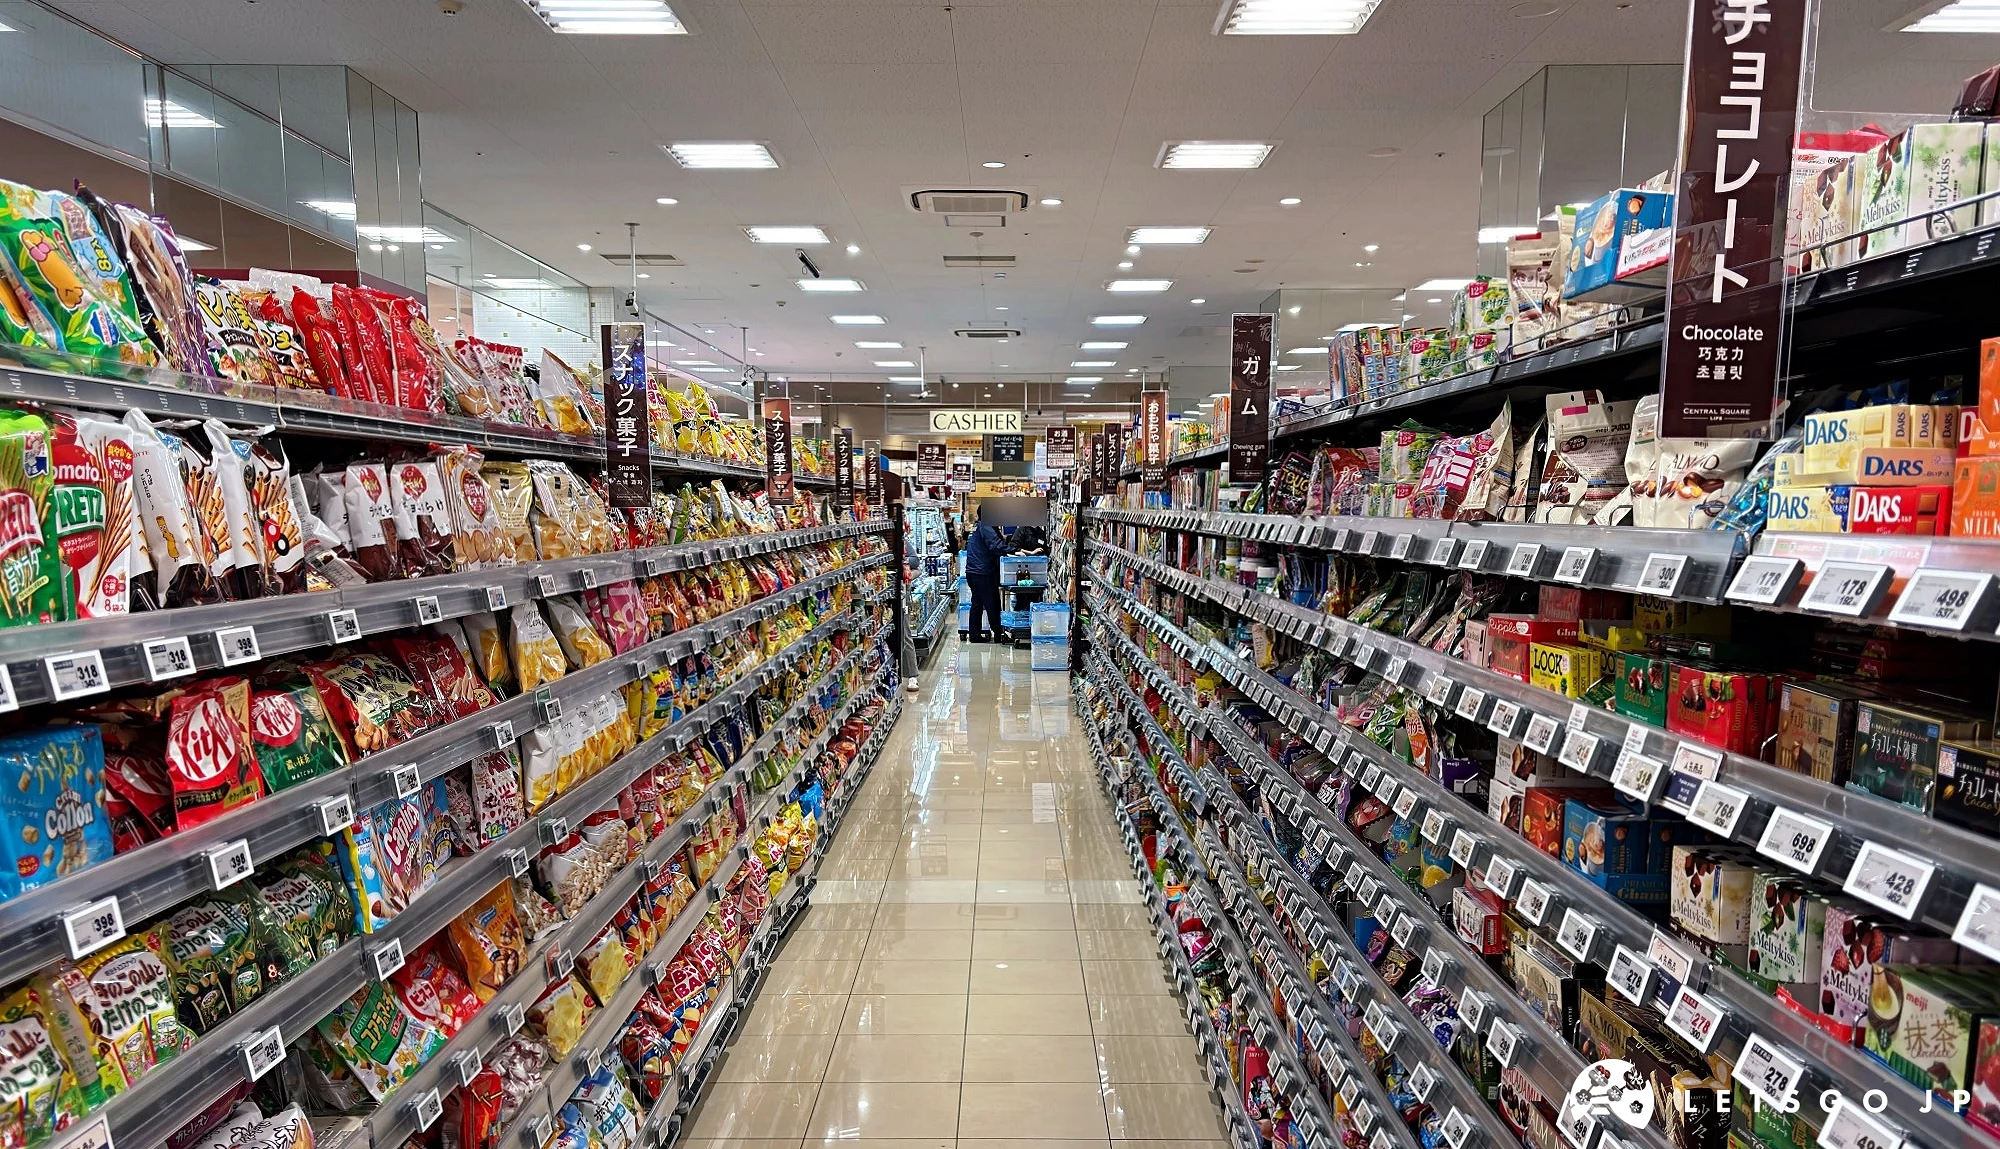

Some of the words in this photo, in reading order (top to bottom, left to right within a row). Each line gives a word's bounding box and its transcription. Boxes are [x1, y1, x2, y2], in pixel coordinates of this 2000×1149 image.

[1712, 0, 1771, 303] チョコレート
[1865, 199, 1900, 225] Meltykiss
[1682, 325, 1763, 341] Chocolate
[1698, 347, 1744, 362] 巧克力
[1241, 355, 1261, 416] ガム
[614, 344, 638, 457] スナック菓子
[1682, 407, 1718, 415] CENTRAL
[1719, 407, 1751, 416] SQUARE
[933, 413, 1017, 430] CASHIER
[1805, 415, 1848, 447] DARS
[1895, 411, 1906, 438] DARS
[1919, 412, 1929, 439] DARS
[772, 410, 787, 477] スナック菓子
[1108, 433, 1116, 473] ビスケット
[1233, 443, 1254, 451] Chewing
[1693, 440, 1709, 449] meiji
[838, 436, 851, 485] スナック菓子
[1095, 443, 1103, 477] キャンディ
[1864, 456, 1924, 477] DARS
[53, 463, 100, 482] omato
[1768, 488, 1810, 521] DARS
[1853, 491, 1902, 523] DARS
[1762, 571, 1778, 586] 178
[1842, 579, 1868, 596] 178
[1938, 590, 1966, 608] 498
[238, 637, 252, 650] 398
[1556, 628, 1577, 637] Gha
[169, 649, 188, 663] 318
[1533, 647, 1564, 676] LOOK
[77, 664, 98, 681] 318
[259, 697, 296, 733] KitKat
[1733, 700, 1743, 732] Rummy
[171, 702, 233, 776] KitKat
[1871, 732, 1919, 762] チョコレート効果
[45, 801, 94, 839] Collon
[1715, 801, 1735, 819] 768
[1791, 832, 1816, 854] 698
[231, 853, 247, 869] 398
[1886, 871, 1915, 894] 428
[94, 912, 116, 932] 398
[1675, 899, 1713, 930] Meltykiss
[1573, 928, 1588, 946] 398
[1756, 930, 1796, 968] Meltykiss
[1626, 971, 1643, 988] 278
[1829, 969, 1868, 1004] Meltyki
[407, 983, 438, 1008] ビスコ
[1906, 991, 1929, 1011] meiji
[101, 980, 171, 1036] たけのこの里
[353, 1012, 369, 1035] LOTTE
[1691, 1012, 1711, 1032] 278
[1903, 1020, 1958, 1053] 抹茶
[264, 1040, 280, 1058] 298
[1909, 1045, 1958, 1061] Chocolate
[1764, 1066, 1789, 1091] 278
[1573, 1119, 1588, 1138] 298
